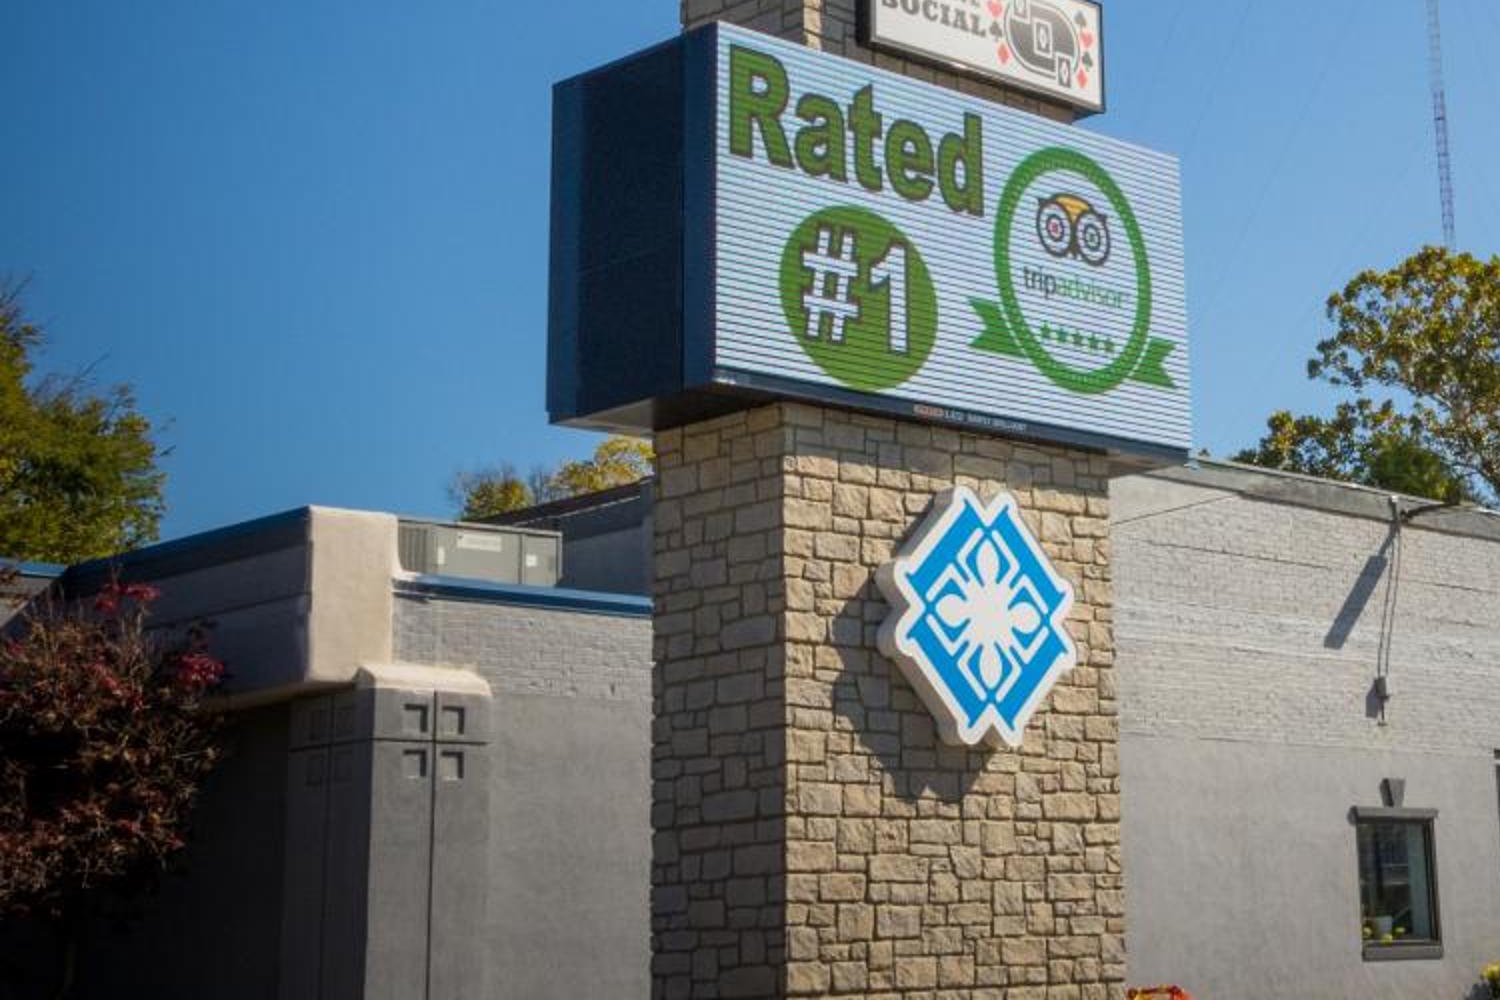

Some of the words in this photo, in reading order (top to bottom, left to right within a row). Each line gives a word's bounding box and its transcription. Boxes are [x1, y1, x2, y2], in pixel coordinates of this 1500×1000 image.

[729, 43, 985, 217] Rated
[799, 220, 912, 357] #1
[1022, 264, 1124, 309] tripadvisor
